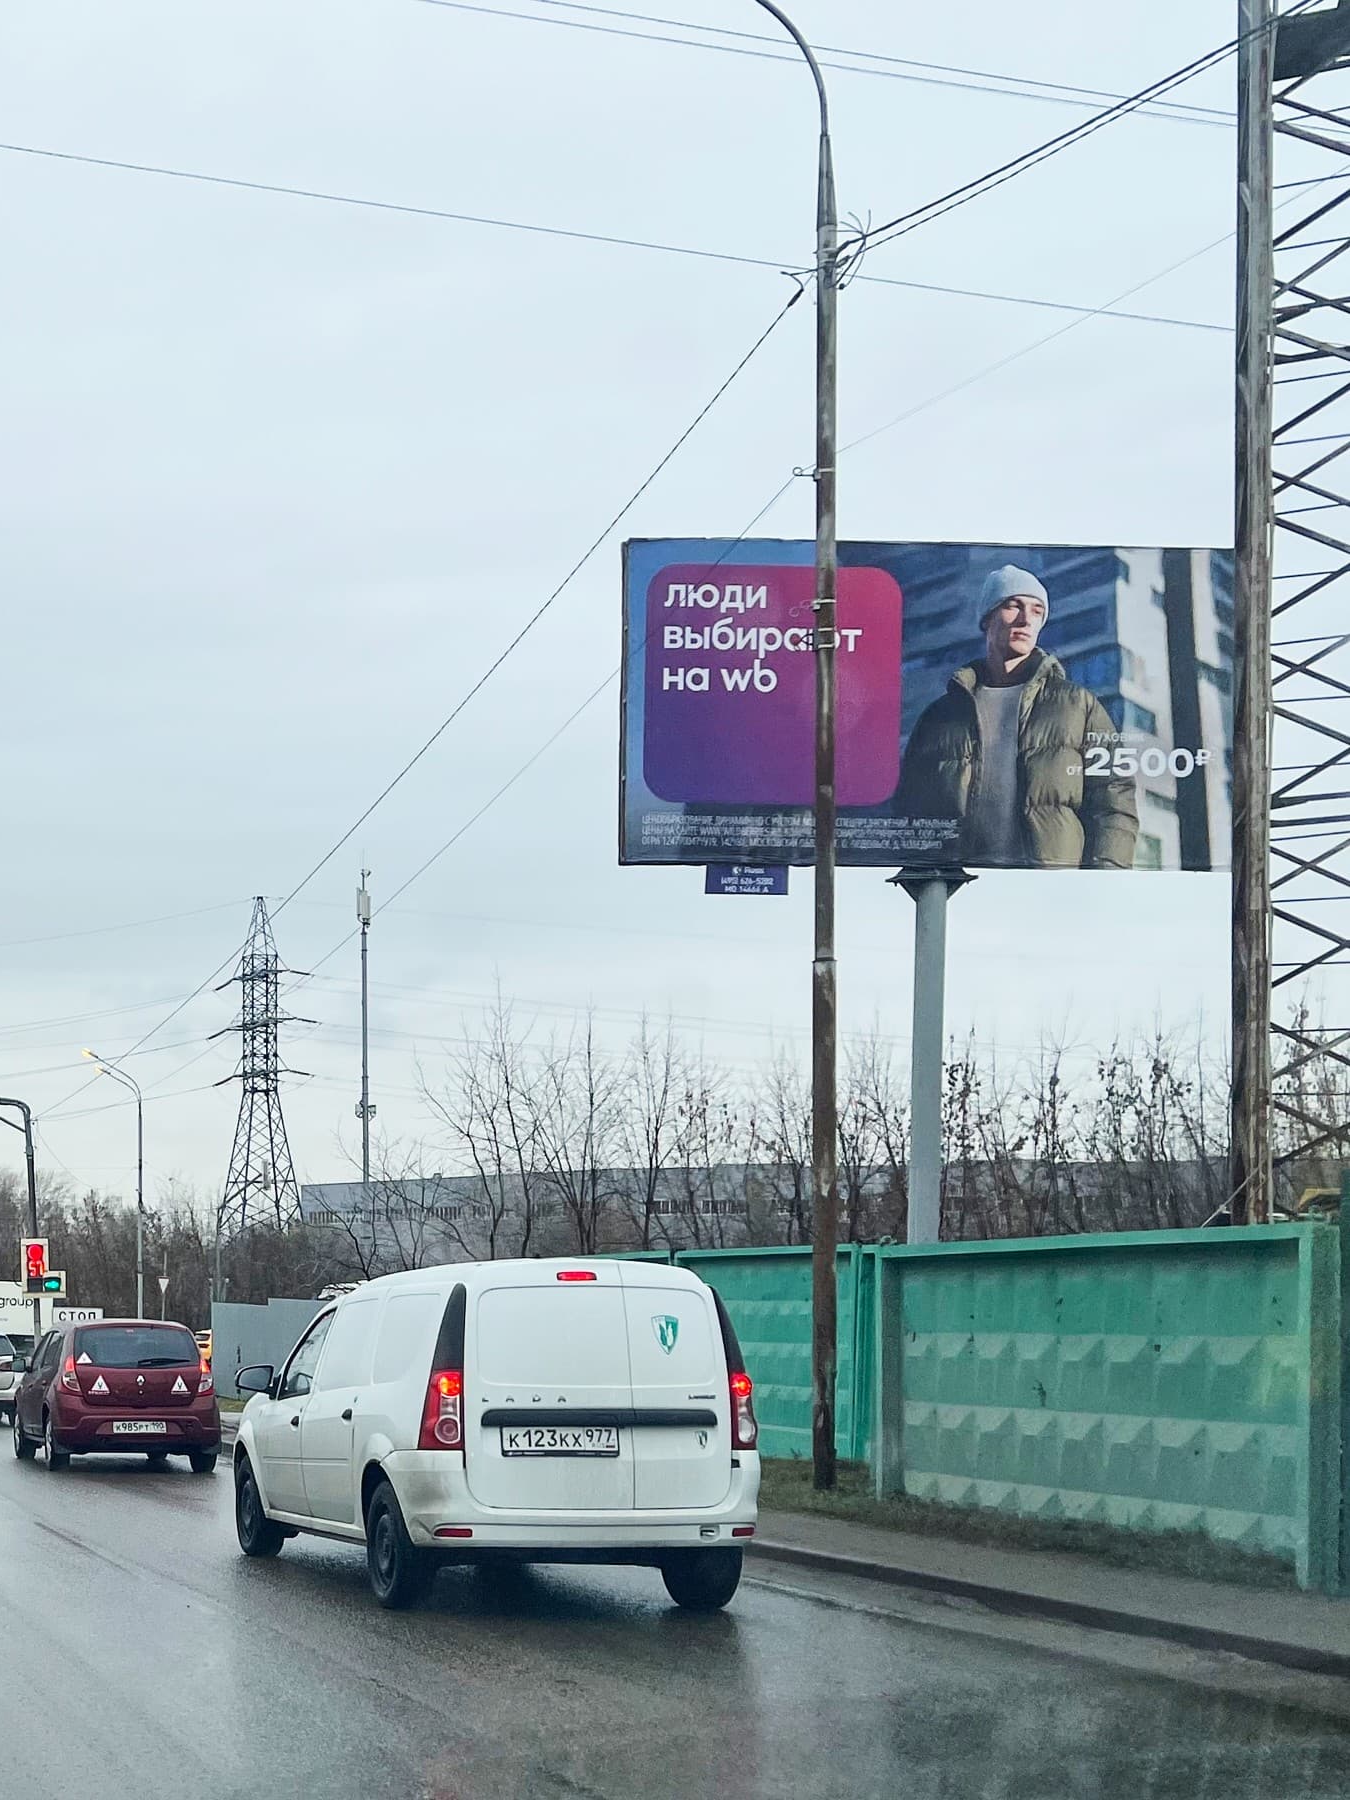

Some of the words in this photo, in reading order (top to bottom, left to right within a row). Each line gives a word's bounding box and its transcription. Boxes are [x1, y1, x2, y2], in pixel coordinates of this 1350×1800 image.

[664, 584, 767, 613] люди
[662, 667, 710, 691] на
[720, 659, 778, 693] wb
[58, 1311, 96, 1321] СТОП
[509, 1429, 582, 1448] К123КХ
[585, 1429, 612, 1442] 977
